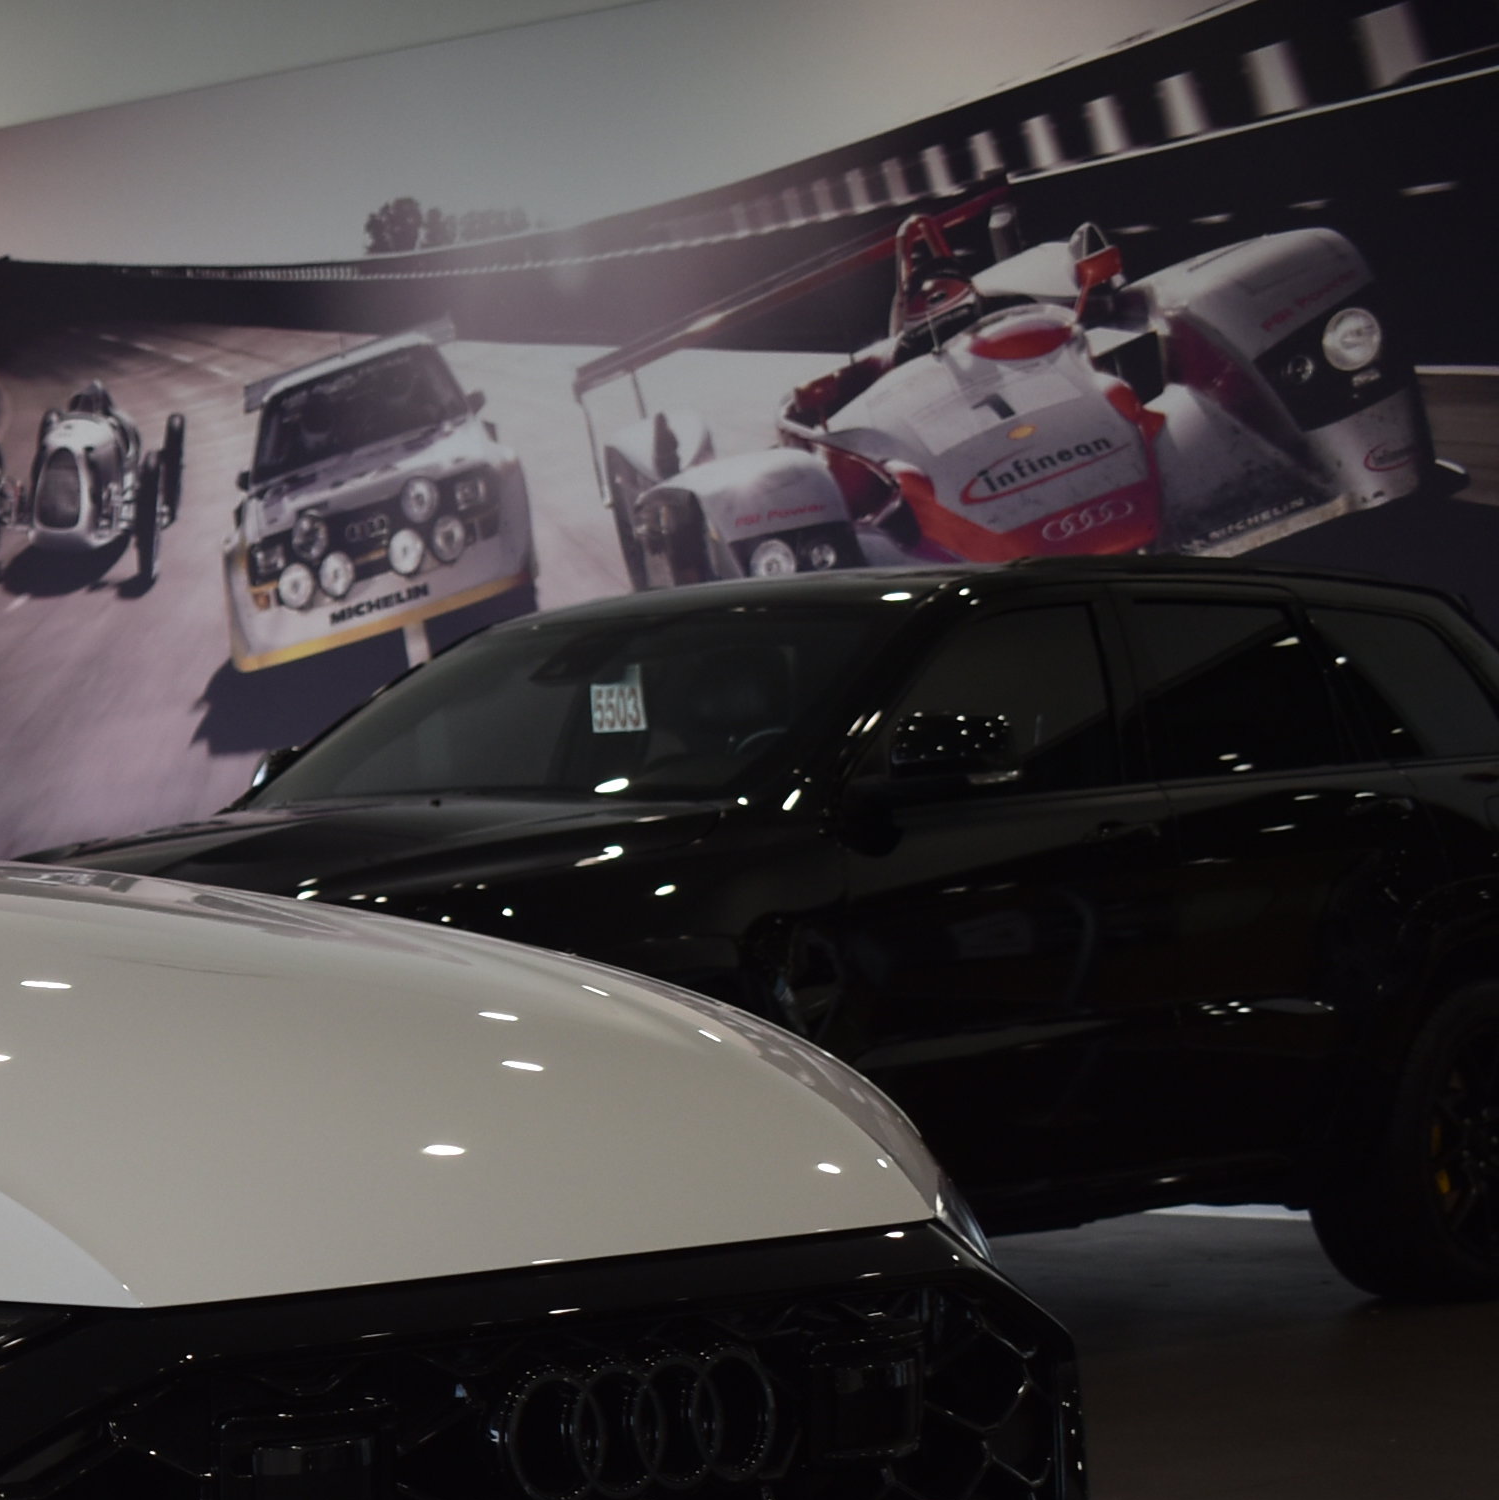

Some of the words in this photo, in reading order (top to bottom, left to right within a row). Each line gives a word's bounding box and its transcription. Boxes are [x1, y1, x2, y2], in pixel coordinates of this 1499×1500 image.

[977, 437, 1112, 493] Infineon
[1207, 496, 1306, 541] MICHELIN
[329, 583, 430, 625] MICHELIN
